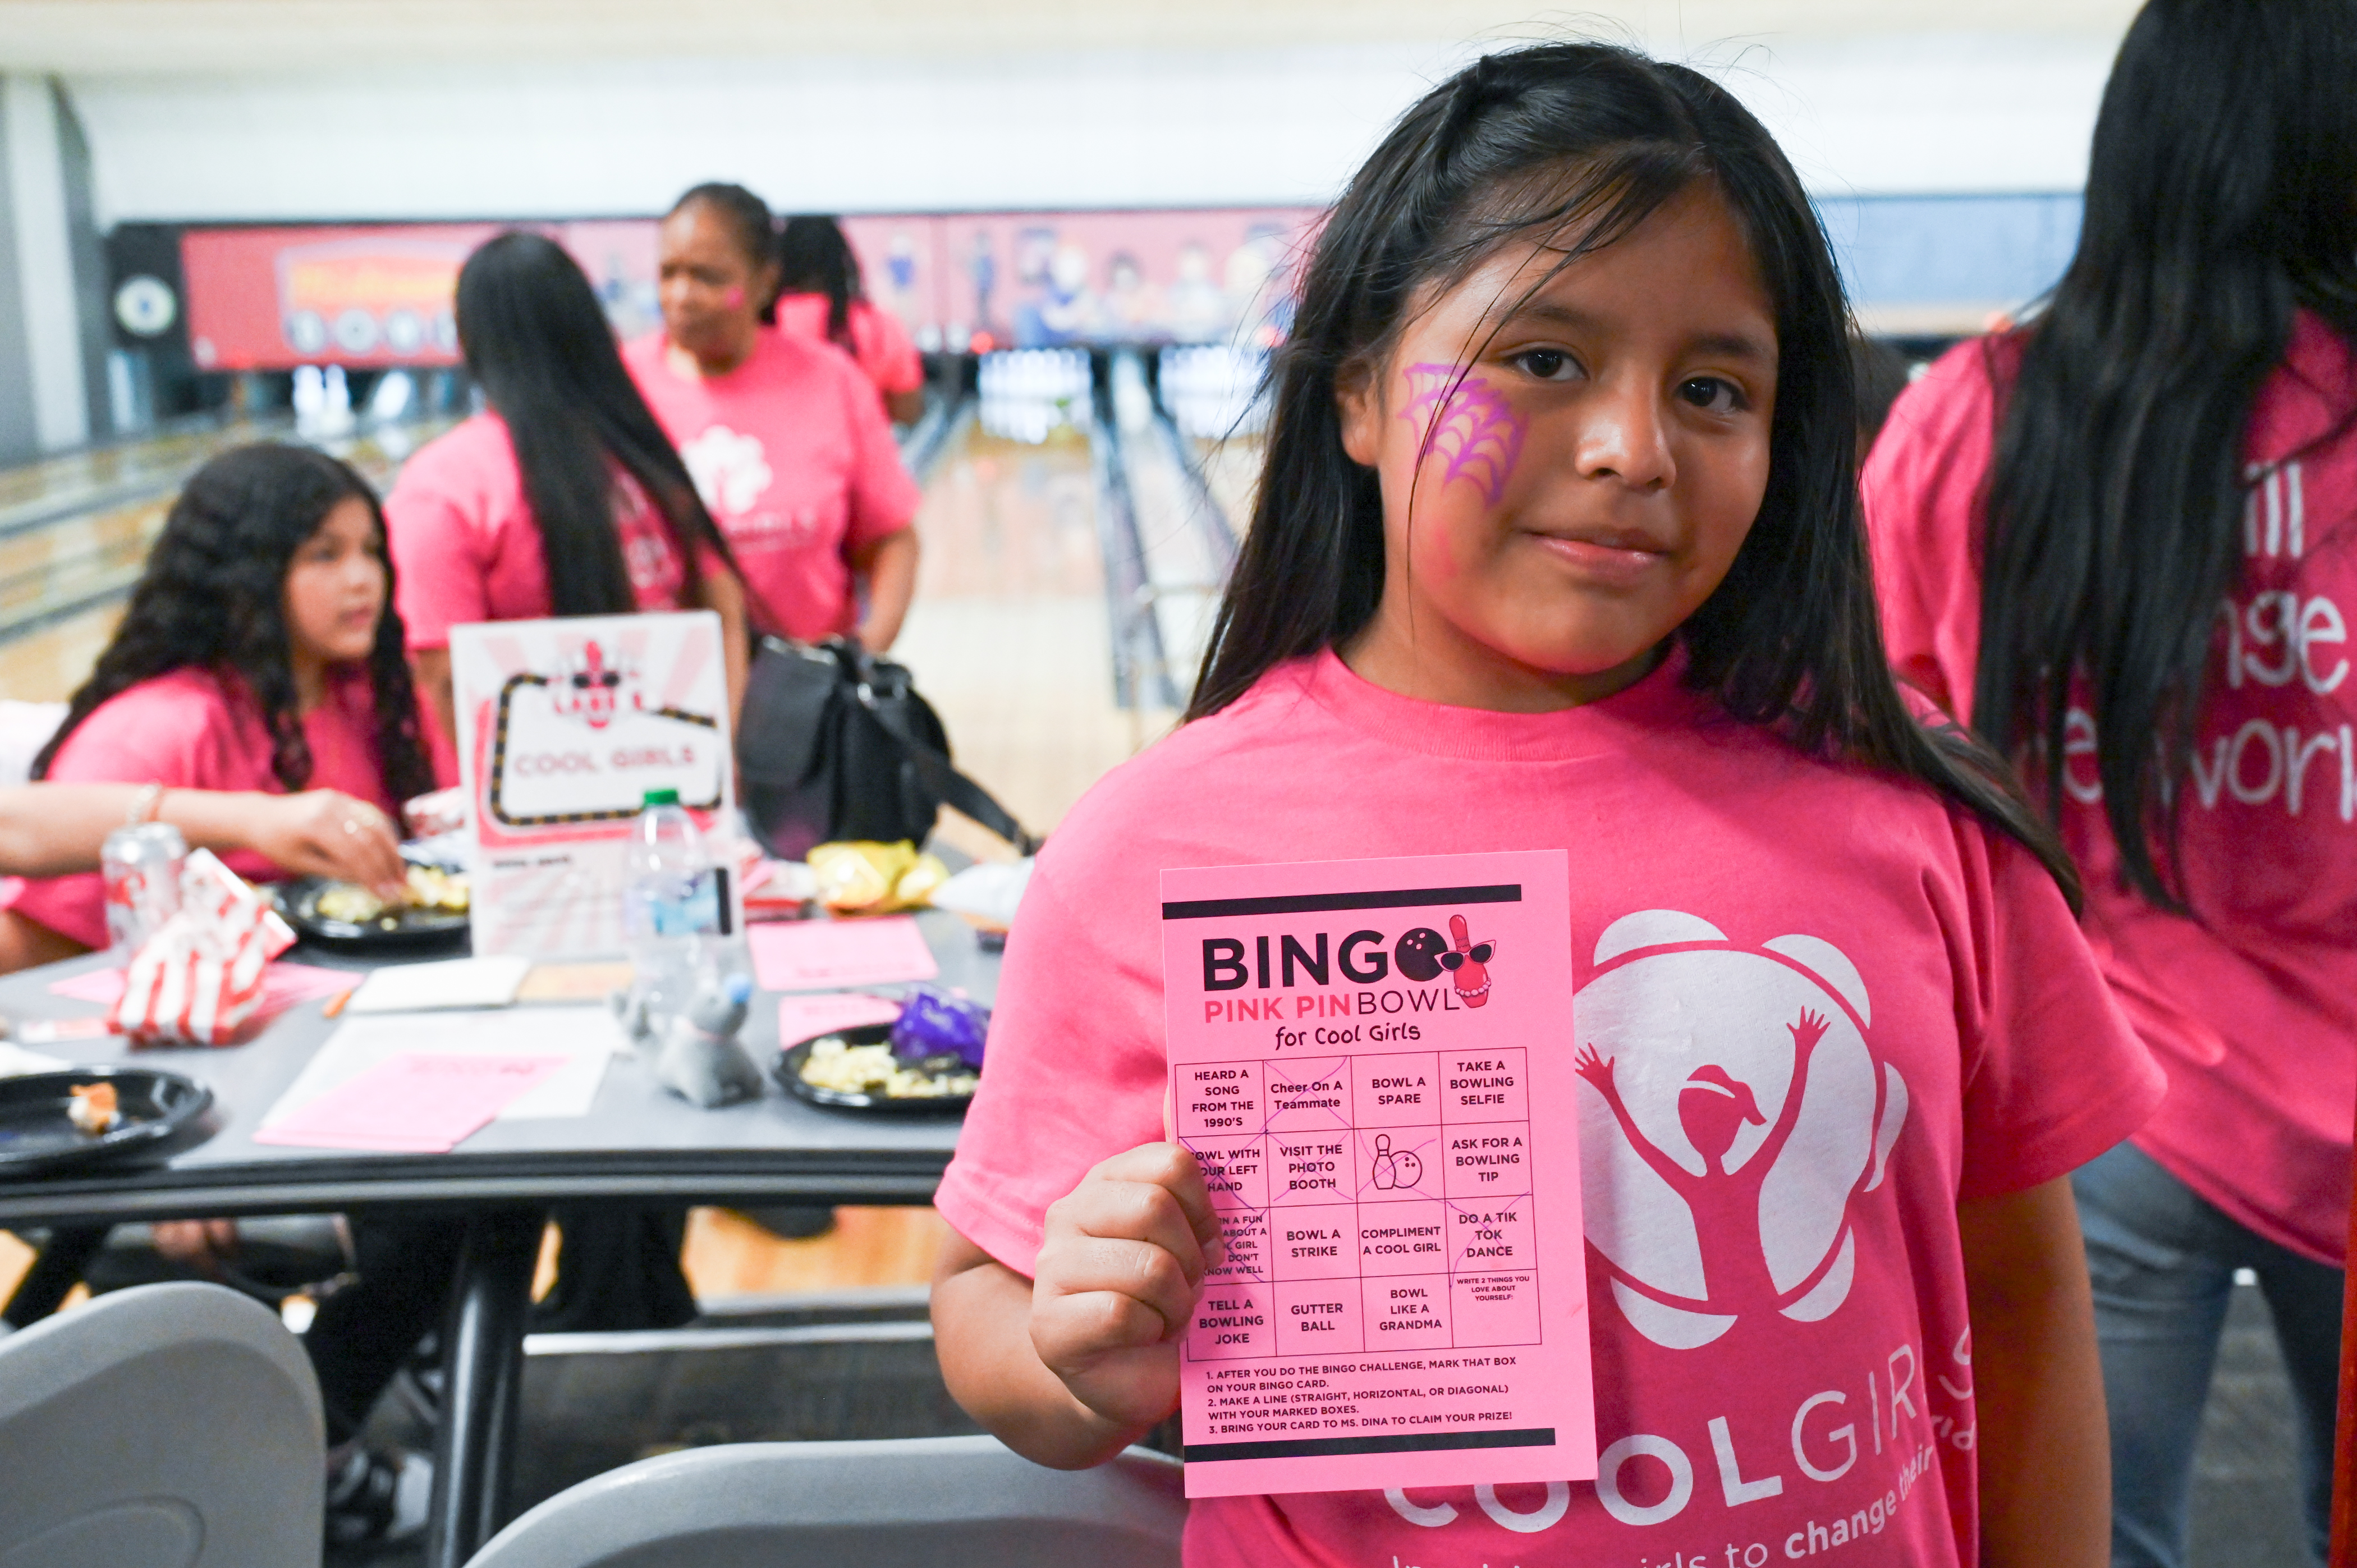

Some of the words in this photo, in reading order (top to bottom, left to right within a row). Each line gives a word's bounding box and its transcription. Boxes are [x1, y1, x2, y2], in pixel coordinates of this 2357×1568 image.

[2246, 461, 2303, 557] ill
[1202, 927, 1449, 992] BINGO
[1205, 996, 1284, 1023] PINK
[1275, 1026, 1307, 1051] for
[1315, 1024, 1361, 1045] Cool
[1370, 1022, 1421, 1042] Girls
[1457, 1061, 1492, 1072] TAKE
[1496, 1061, 1506, 1070] A
[1195, 1070, 1236, 1080] HEARD
[1241, 1070, 1249, 1078] A
[1271, 1083, 1308, 1094] Cheer
[1312, 1081, 1329, 1091] On
[1333, 1081, 1342, 1090] A
[1372, 1078, 1413, 1088] BOWL
[1417, 1077, 1426, 1086] A
[1450, 1076, 1514, 1089] BOWLING
[1205, 1086, 1240, 1096] SONG
[1274, 1098, 1341, 1109] Teammate
[1378, 1094, 1421, 1105] SPARE
[1461, 1094, 1505, 1105] SELFIE
[1193, 1102, 1227, 1112] FROM
[1231, 1101, 1254, 1111] THE
[1204, 1117, 1243, 1127] 1990'S
[1451, 1139, 1478, 1150] ASK
[1482, 1138, 1509, 1148] FOR
[1513, 1137, 1523, 1147] A
[1191, 1150, 1225, 1160] OWL
[1228, 1149, 1260, 1158] WITH
[1280, 1146, 1313, 1156] VISIT
[1317, 1144, 1342, 1154] THE
[1456, 1154, 1520, 1166] BOWLING
[1201, 1167, 1225, 1176] OUR
[1229, 1165, 1258, 1175] LEFT
[1289, 1162, 1335, 1173] PHOTO
[1478, 1172, 1498, 1182] TIP
[1208, 1182, 1242, 1192] HAND
[1290, 1179, 1336, 1190] BOOTH
[1459, 1214, 1478, 1224] DO
[1483, 1213, 1492, 1223] A
[1496, 1212, 1517, 1222] TIK
[1223, 1228, 1257, 1237] ABOUT
[1287, 1230, 1327, 1241] BOWL
[1331, 1229, 1341, 1239] A
[1361, 1226, 1441, 1239] COMPLIMENT
[1475, 1230, 1503, 1240] TOK
[1235, 1241, 1258, 1249] GIRL
[1363, 1246, 1372, 1255] A
[1375, 1244, 1410, 1254] COOL
[1413, 1243, 1441, 1253] GIRL
[1228, 1253, 1259, 1262] DON'T
[1291, 1246, 1338, 1258] STRIKE
[1467, 1246, 1513, 1258] DANCE
[1236, 1266, 1263, 1274] WELL
[1390, 1289, 1428, 1299] BOWL
[1208, 1300, 1240, 1311] TELL
[1244, 1299, 1253, 1309] A
[1291, 1303, 1343, 1315] GUTTER
[1391, 1304, 1417, 1314] LIKE
[1421, 1304, 1429, 1313] A
[1199, 1315, 1264, 1329] BOWLING
[1301, 1321, 1335, 1331] BALL
[1379, 1319, 1442, 1331] GRANDMA
[1215, 1333, 1250, 1345] JOKE
[1207, 1372, 1213, 1380] 1.
[1217, 1369, 1250, 1379] AFTER
[1254, 1368, 1276, 1377] YOU
[1280, 1367, 1295, 1376] DO
[1299, 1366, 1319, 1375] THE
[1322, 1364, 1356, 1374] BINGO
[1360, 1361, 1426, 1372] CHALLENGE,
[1429, 1359, 1460, 1369] MARK
[1462, 1358, 1491, 1367] THAT
[1494, 1356, 1516, 1366] BOX
[1207, 1384, 1223, 1393] ON
[1226, 1383, 1256, 1392] YOUR
[1259, 1381, 1293, 1390] BINGO
[1296, 1379, 1329, 1388] CARD.
[1208, 1399, 1216, 1407] 2.
[1220, 1397, 1249, 1406] MAKE
[1263, 1395, 1287, 1404] LINE
[1291, 1392, 1350, 1404] (STRAIGHT,
[1354, 1388, 1426, 1400] HORIZONTAL,
[1429, 1387, 1444, 1396] OR
[1448, 1384, 1508, 1395] DIAGONAL)
[1208, 1411, 1236, 1420] WITH
[1240, 1409, 1269, 1419] YOUR
[1273, 1407, 1318, 1417] MARKED
[1321, 1405, 1359, 1415] BOXES.
[1209, 1426, 1218, 1434] 3.
[1221, 1424, 1254, 1433] BRING
[1257, 1422, 1287, 1431] YOUR
[1291, 1420, 1319, 1430] CARD
[1323, 1420, 1337, 1428] TO
[1341, 1419, 1358, 1428] MS.
[1362, 1417, 1388, 1426] DINA
[1391, 1416, 1406, 1425] TO
[1409, 1415, 1442, 1424] CLAIM
[1445, 1413, 1475, 1422] YOUR
[1479, 1411, 1512, 1420] PRIZE!
[1725, 1543, 1768, 1568] to
[1785, 1489, 1897, 1559] change
[1899, 1443, 1934, 1502] their
